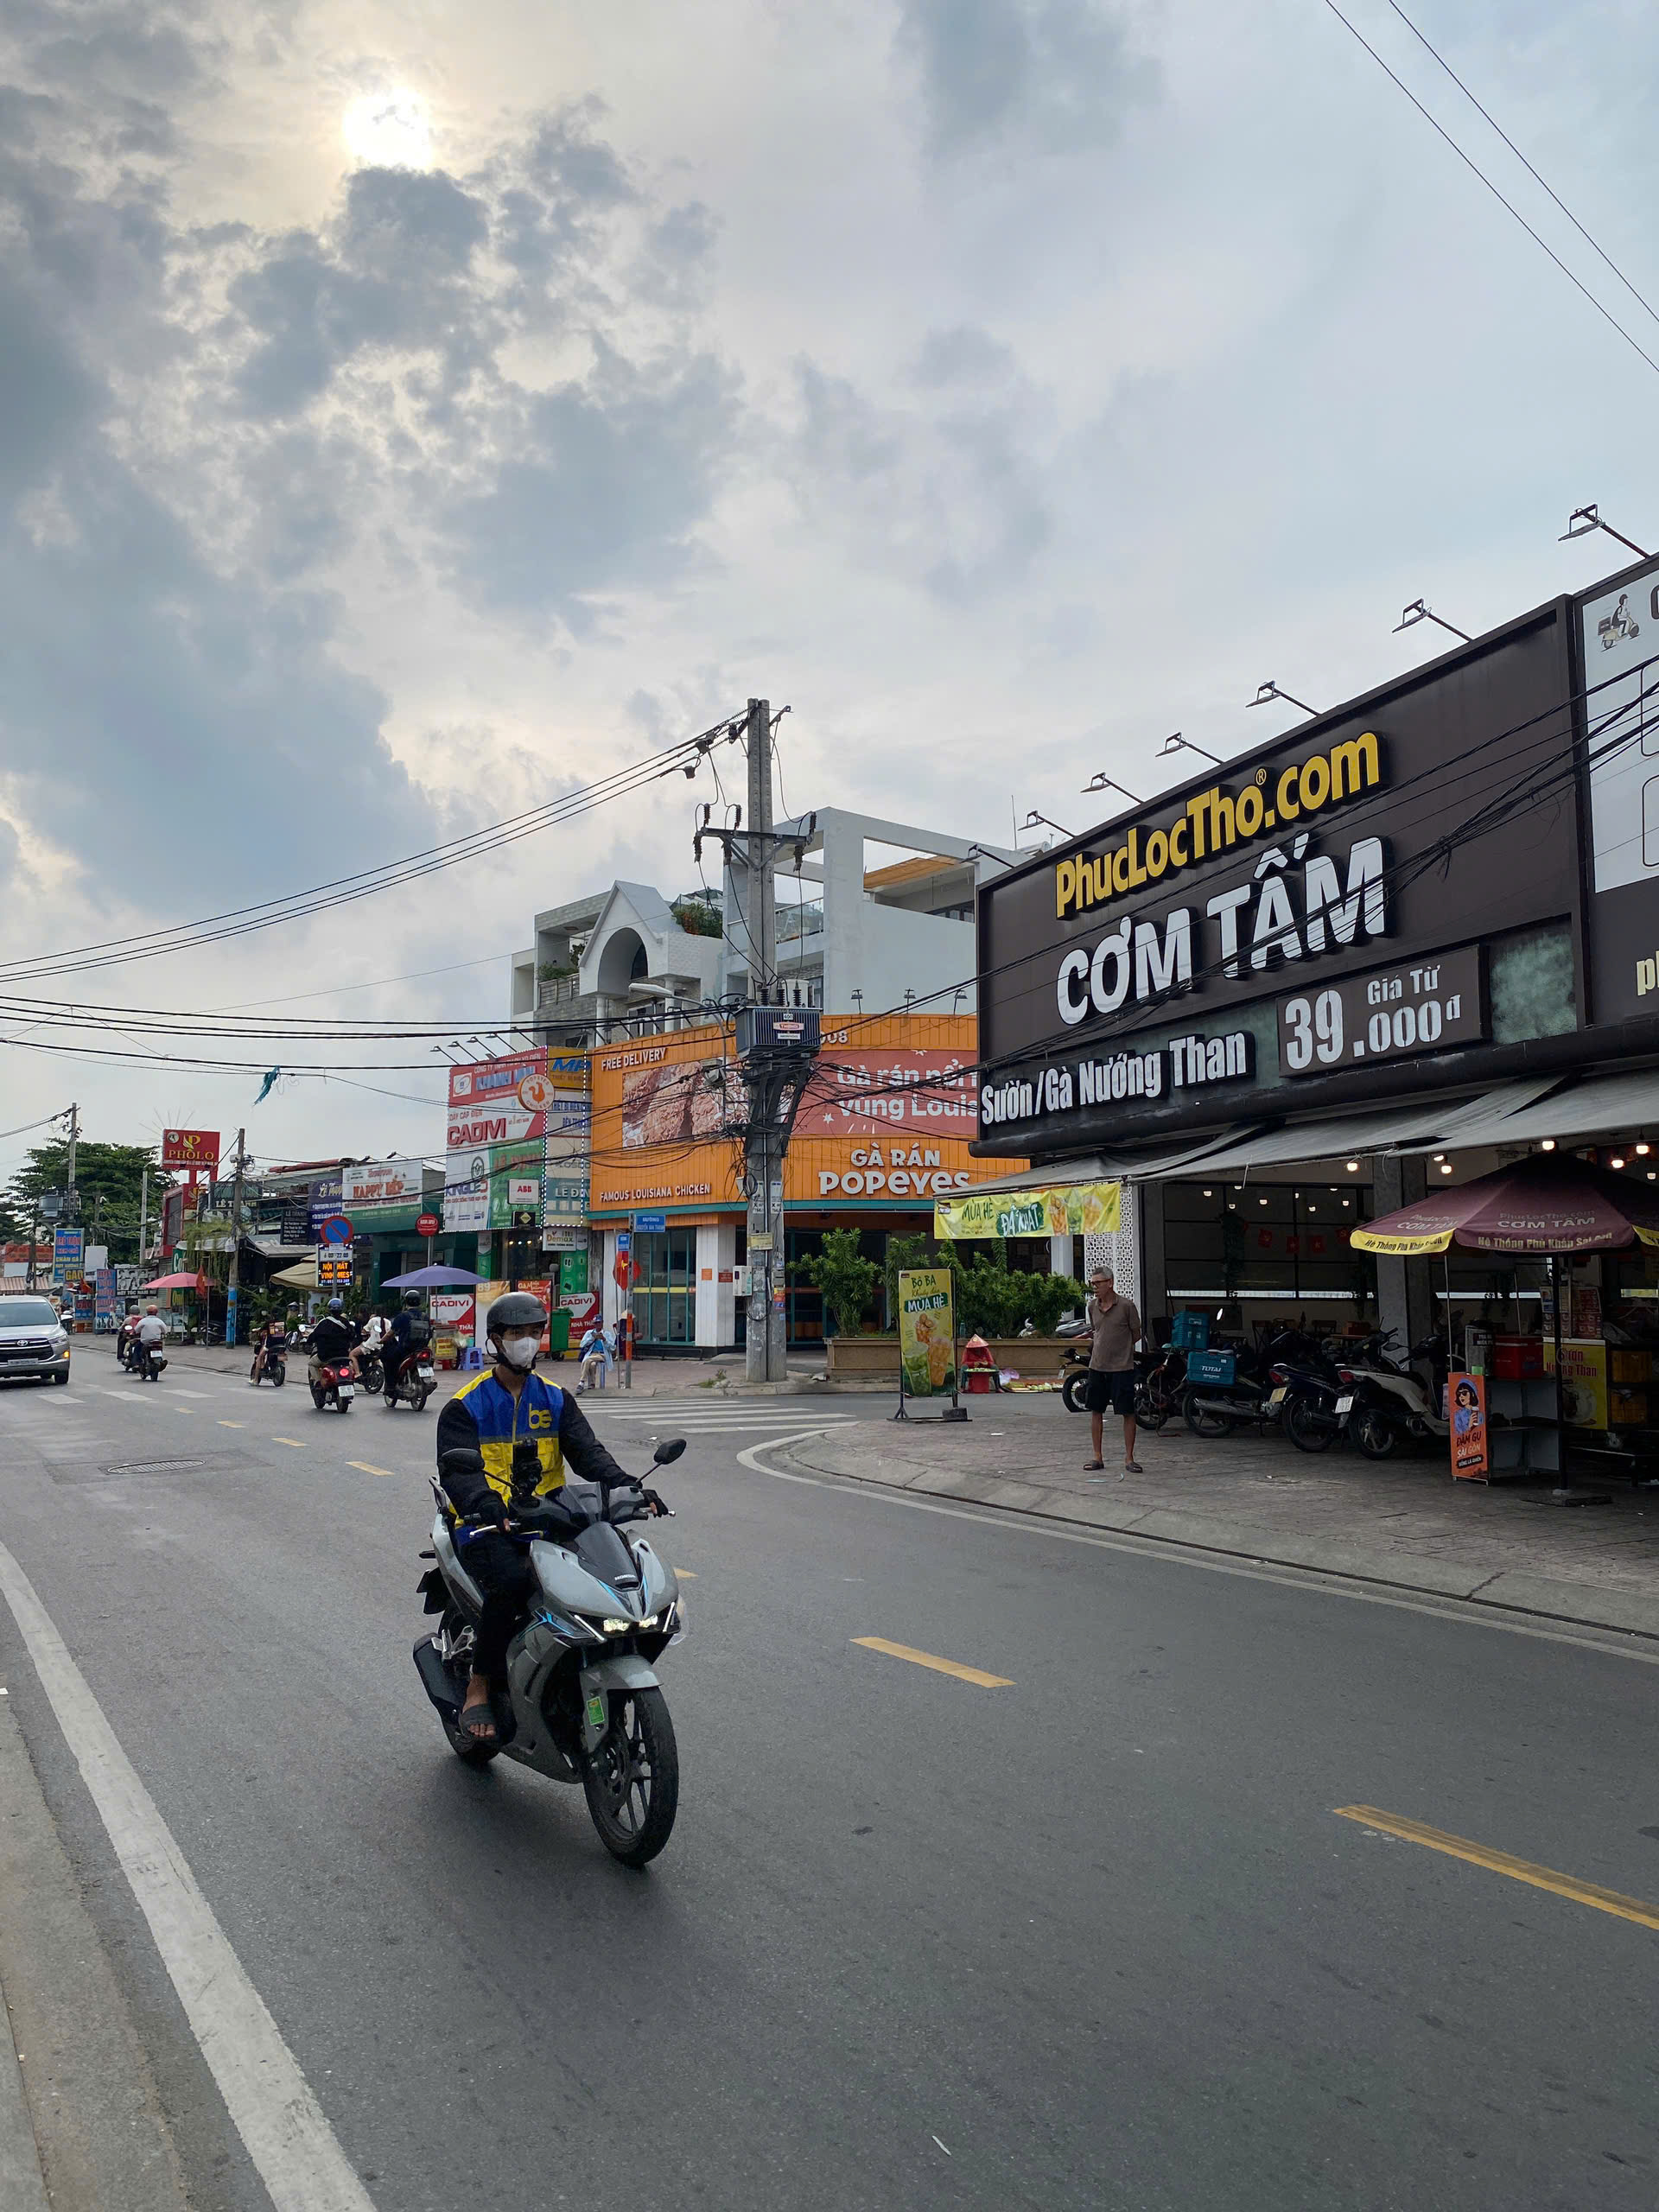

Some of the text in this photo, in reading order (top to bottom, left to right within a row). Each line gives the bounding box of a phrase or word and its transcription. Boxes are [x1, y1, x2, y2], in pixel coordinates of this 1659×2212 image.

[1057, 833, 1384, 1025] CƠM TẤM
[1367, 964, 1440, 1006] Giá Từ
[601, 1047, 668, 1071] FREE DELIVERY
[1079, 1052, 1161, 1105] Nướng
[1169, 1032, 1246, 1087] Than
[837, 1065, 867, 1086] Gà
[447, 1117, 507, 1146] CADIVI
[851, 1142, 940, 1166] GÀ RÁN
[555, 1185, 569, 1198] LÊ
[600, 1183, 710, 1203] FAMOUS LOUISIANA CHICKEN
[215, 1198, 226, 1207] LÊ
[962, 1198, 982, 1222] MÙA
[983, 1196, 995, 1221] HÈ
[1497, 1215, 1596, 1229] CƠM TẤM
[1478, 1236, 1491, 1247] Hệ
[1494, 1236, 1523, 1249] Thống
[925, 1274, 937, 1287] BA
[560, 1297, 593, 1306] CADIVI
[907, 1293, 946, 1313] MÙA HÈ
[1575, 1363, 1598, 1377] Than
[529, 1402, 553, 1430] be
[1471, 1430, 1482, 1442] GU
